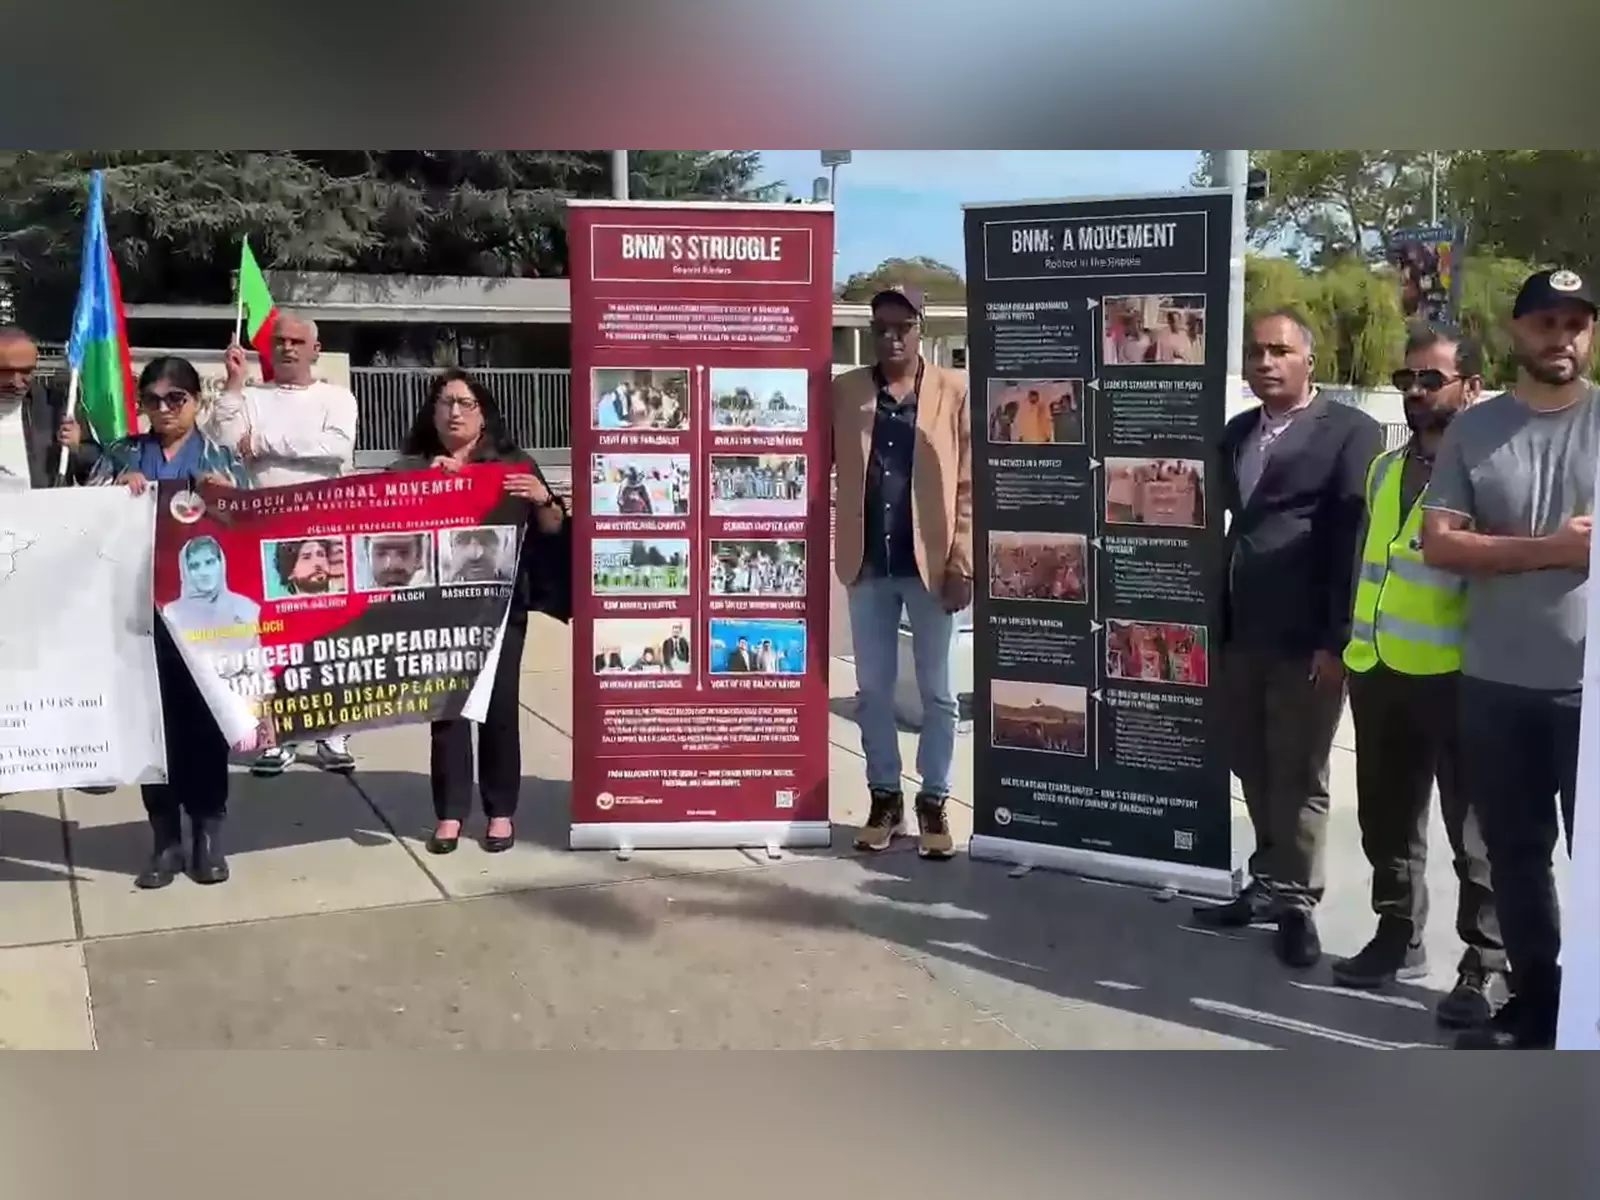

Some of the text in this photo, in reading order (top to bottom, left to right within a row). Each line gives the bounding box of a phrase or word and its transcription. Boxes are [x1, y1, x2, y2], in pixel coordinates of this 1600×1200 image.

[622, 234, 783, 261] BNM'S STRUGGLE
[1012, 223, 1177, 253] BNM: A MOVEMENT
[217, 493, 285, 511] BALOCH
[293, 484, 378, 504] NATIONAL
[385, 478, 474, 497] MOVEMENT
[441, 586, 482, 599] RASHEED
[283, 666, 312, 691] OF
[320, 657, 387, 686] STATE
[275, 697, 429, 733] IN BALOCHISTAN
